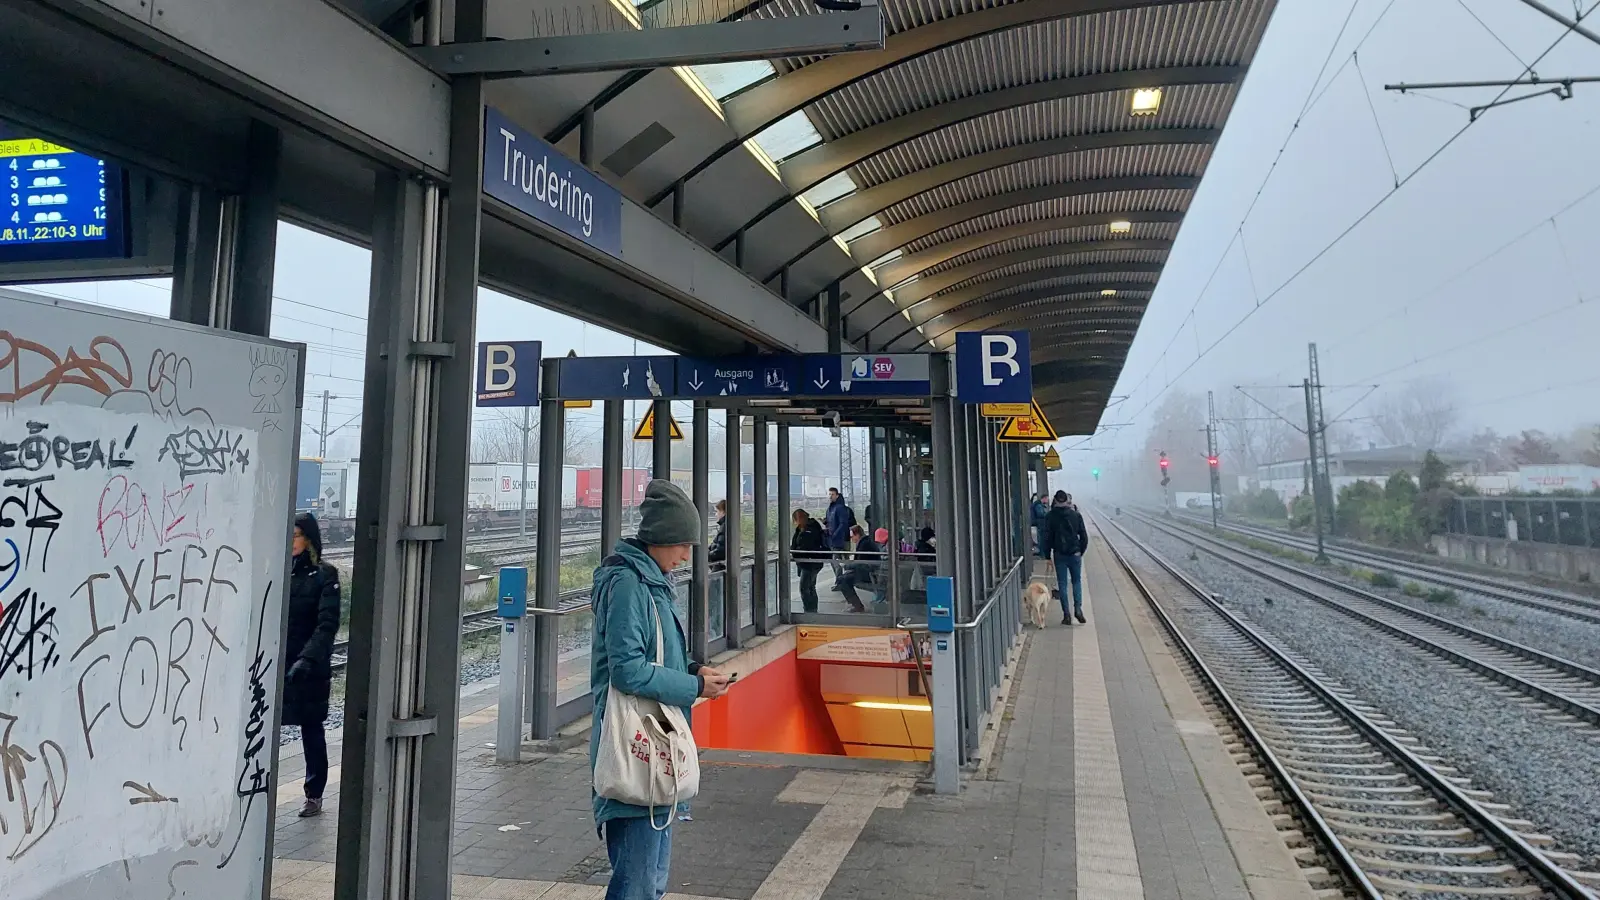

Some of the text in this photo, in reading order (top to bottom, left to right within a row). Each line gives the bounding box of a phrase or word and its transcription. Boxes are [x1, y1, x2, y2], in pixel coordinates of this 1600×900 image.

[29, 142, 36, 152] A
[42, 142, 49, 151] B
[9, 158, 18, 171] 4
[10, 175, 19, 189] 3
[499, 126, 593, 238] Trudering
[11, 193, 20, 206] 3
[11, 211, 20, 223] 4
[82, 224, 105, 237] Uhr
[485, 344, 517, 391] B
[714, 368, 754, 380] Ausgang
[874, 363, 892, 372] SEV
[512, 480, 537, 490] SCHKER
